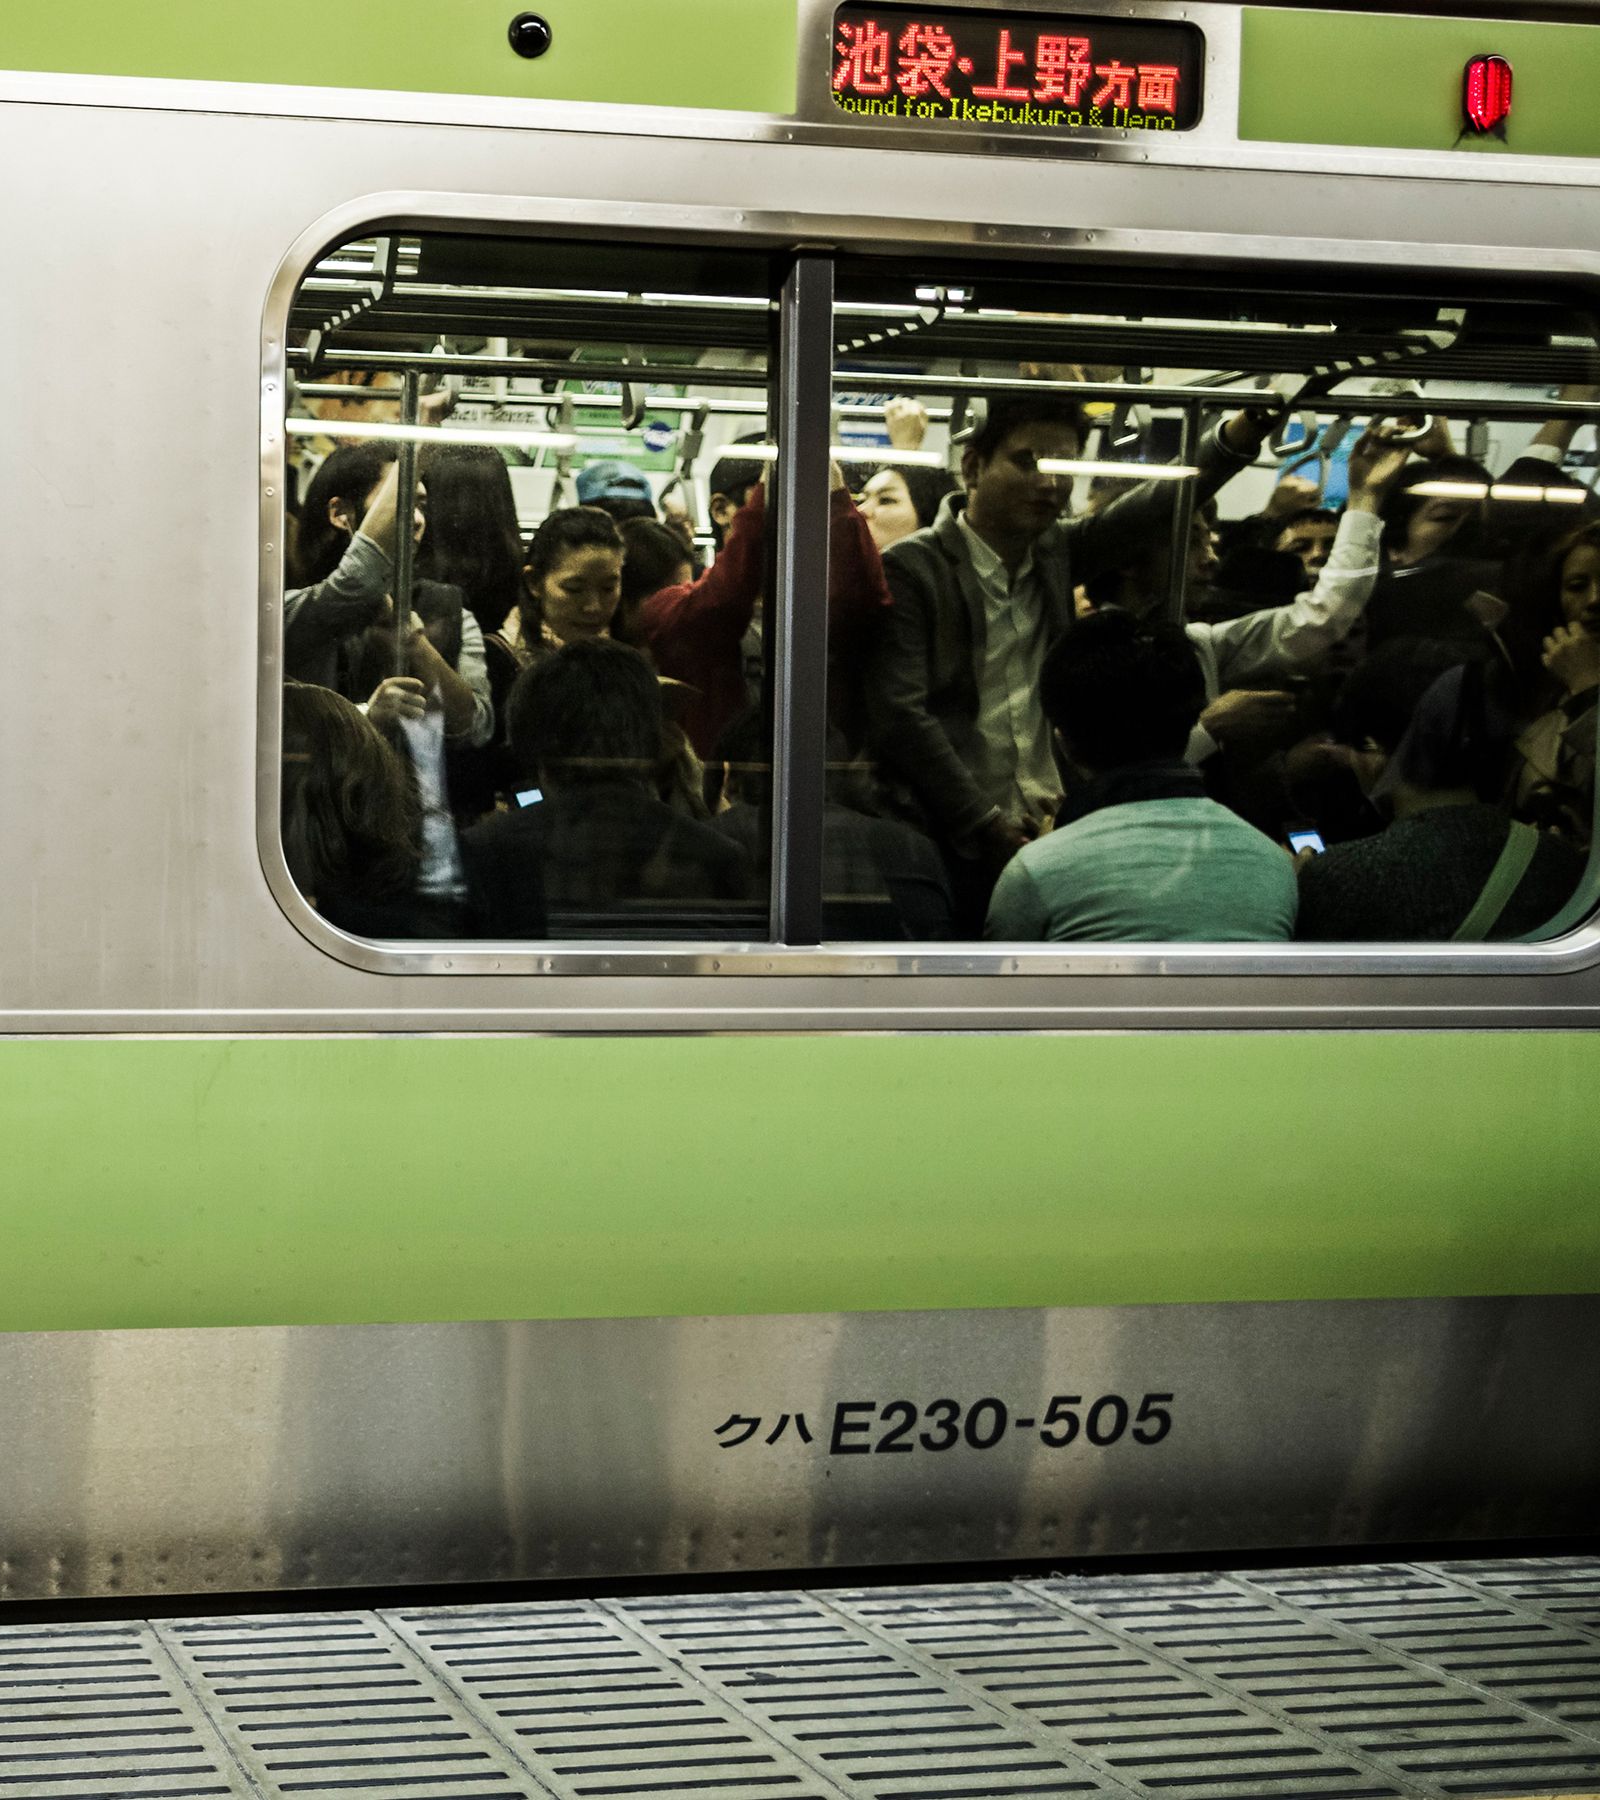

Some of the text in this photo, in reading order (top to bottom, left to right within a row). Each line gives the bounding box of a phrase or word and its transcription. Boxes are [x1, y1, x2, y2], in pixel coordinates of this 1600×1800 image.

[904, 95, 943, 119] for
[949, 98, 1083, 127] Ikebukuro
[1089, 106, 1103, 128] &
[1113, 107, 1176, 130] Ueno
[830, 1393, 1175, 1455] E230-505
